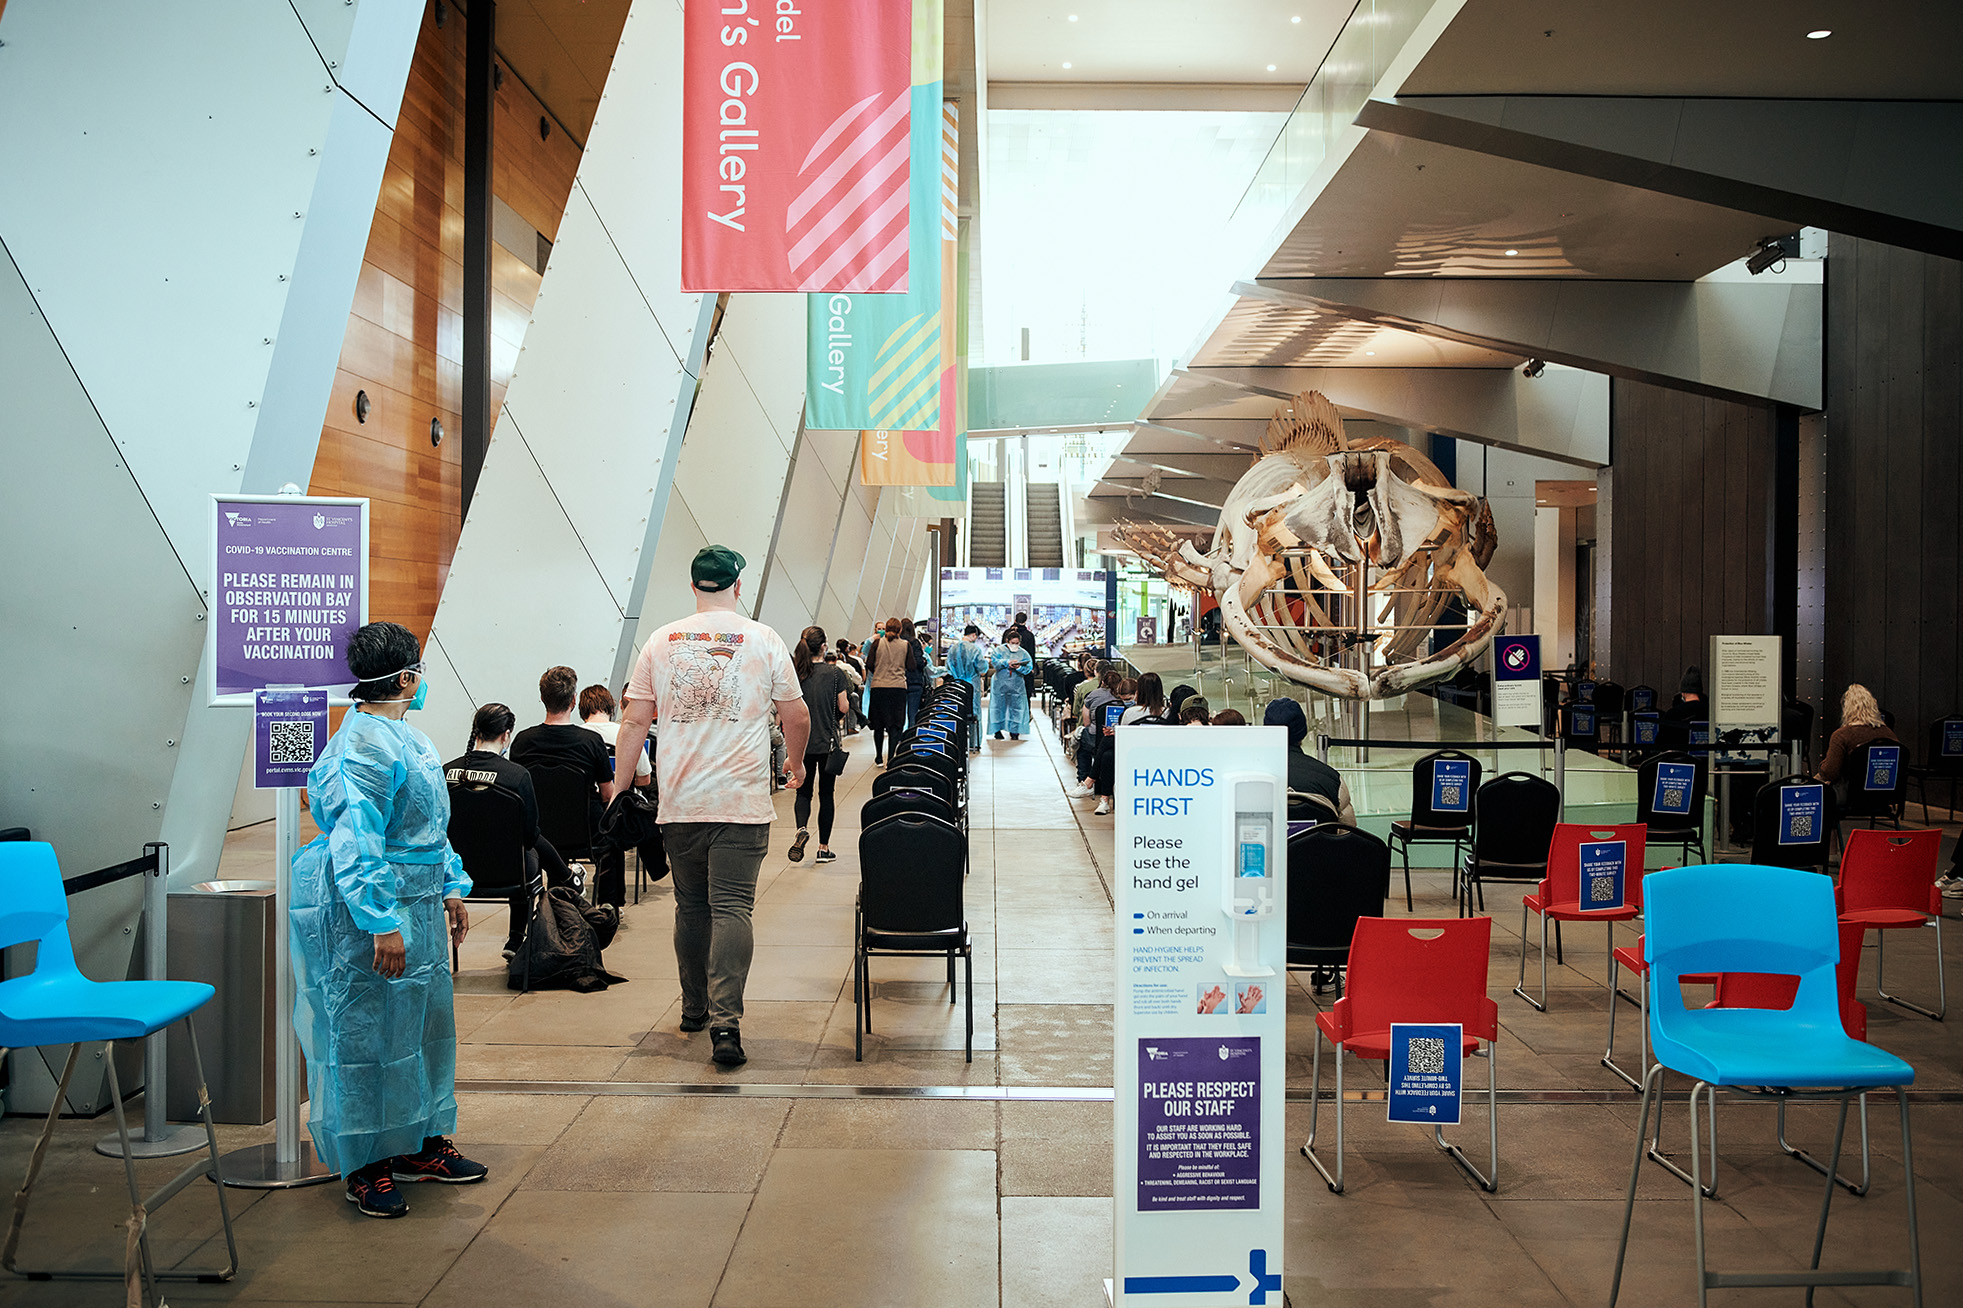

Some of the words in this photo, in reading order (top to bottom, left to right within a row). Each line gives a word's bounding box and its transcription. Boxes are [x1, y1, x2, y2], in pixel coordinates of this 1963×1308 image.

[720, 0, 759, 46] n's
[776, 0, 801, 42] del
[708, 62, 759, 232] Gallery
[821, 294, 852, 395] Gallery
[872, 430, 888, 461] ery
[226, 545, 264, 554] COVID-19
[266, 546, 319, 555] VACCINATION
[321, 547, 352, 556] CENTRE
[223, 573, 276, 588] PLEASE
[281, 574, 335, 588] REMAIN
[340, 575, 354, 589] IN
[226, 591, 320, 606] OBSERVATION
[326, 592, 352, 606] BAY
[231, 609, 258, 623] FOR
[264, 609, 280, 624] 15
[285, 610, 346, 624] MINUTES
[246, 627, 290, 641] AFTER
[295, 627, 331, 641] YOUR
[669, 632, 712, 642] NATIONAL
[715, 633, 744, 643] PARKS
[243, 645, 334, 659] VACCINATION
[448, 769, 495, 781] RICMOND
[1134, 768, 1214, 787] HANDS
[1134, 798, 1193, 816] FIRST
[1134, 836, 1183, 849] Please
[1134, 858, 1160, 869] use
[1165, 855, 1190, 869] the
[1134, 876, 1172, 888] hand
[1177, 876, 1198, 892] gel
[1147, 911, 1160, 919] On
[1162, 910, 1188, 919] arrival
[1147, 926, 1172, 934] When
[1174, 926, 1216, 936] departing
[1144, 1082, 1193, 1098] PLEASE
[1197, 1081, 1256, 1098] RESPECT
[1164, 1100, 1191, 1116] OUR
[1195, 1100, 1235, 1116] STAFF
